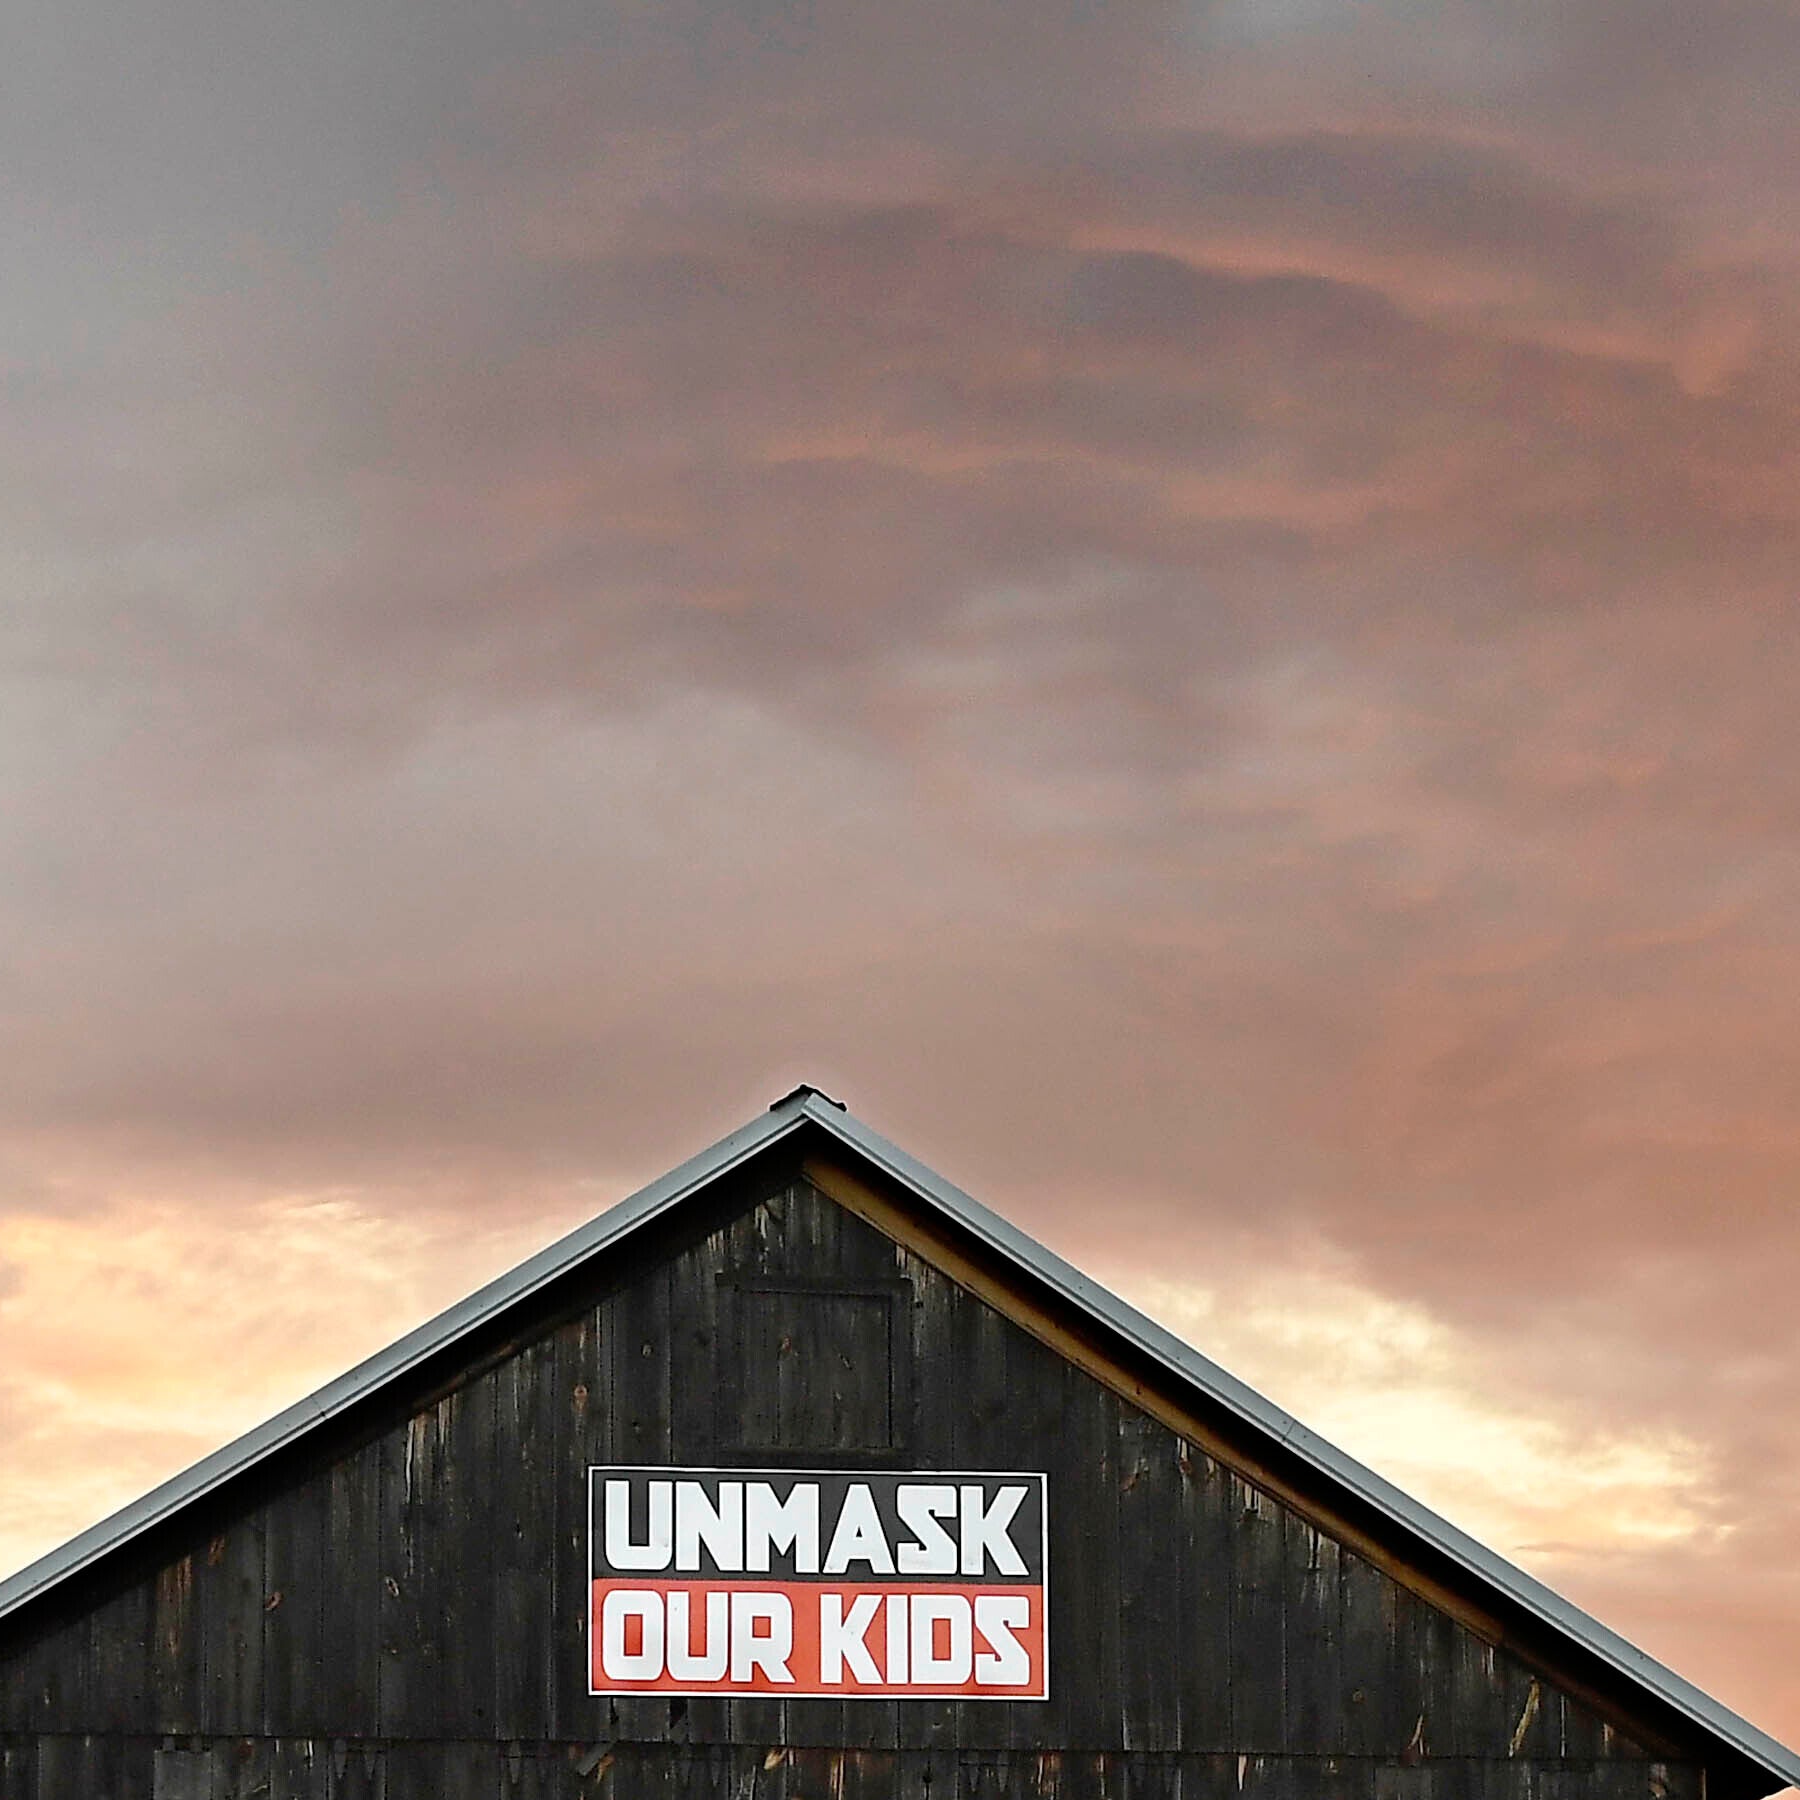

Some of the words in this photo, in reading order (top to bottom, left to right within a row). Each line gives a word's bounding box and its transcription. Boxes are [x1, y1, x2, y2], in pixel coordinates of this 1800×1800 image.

[606, 1480, 1030, 1576] UNMASK
[602, 1589, 796, 1683] OUR
[820, 1593, 1031, 1686] KIDS
